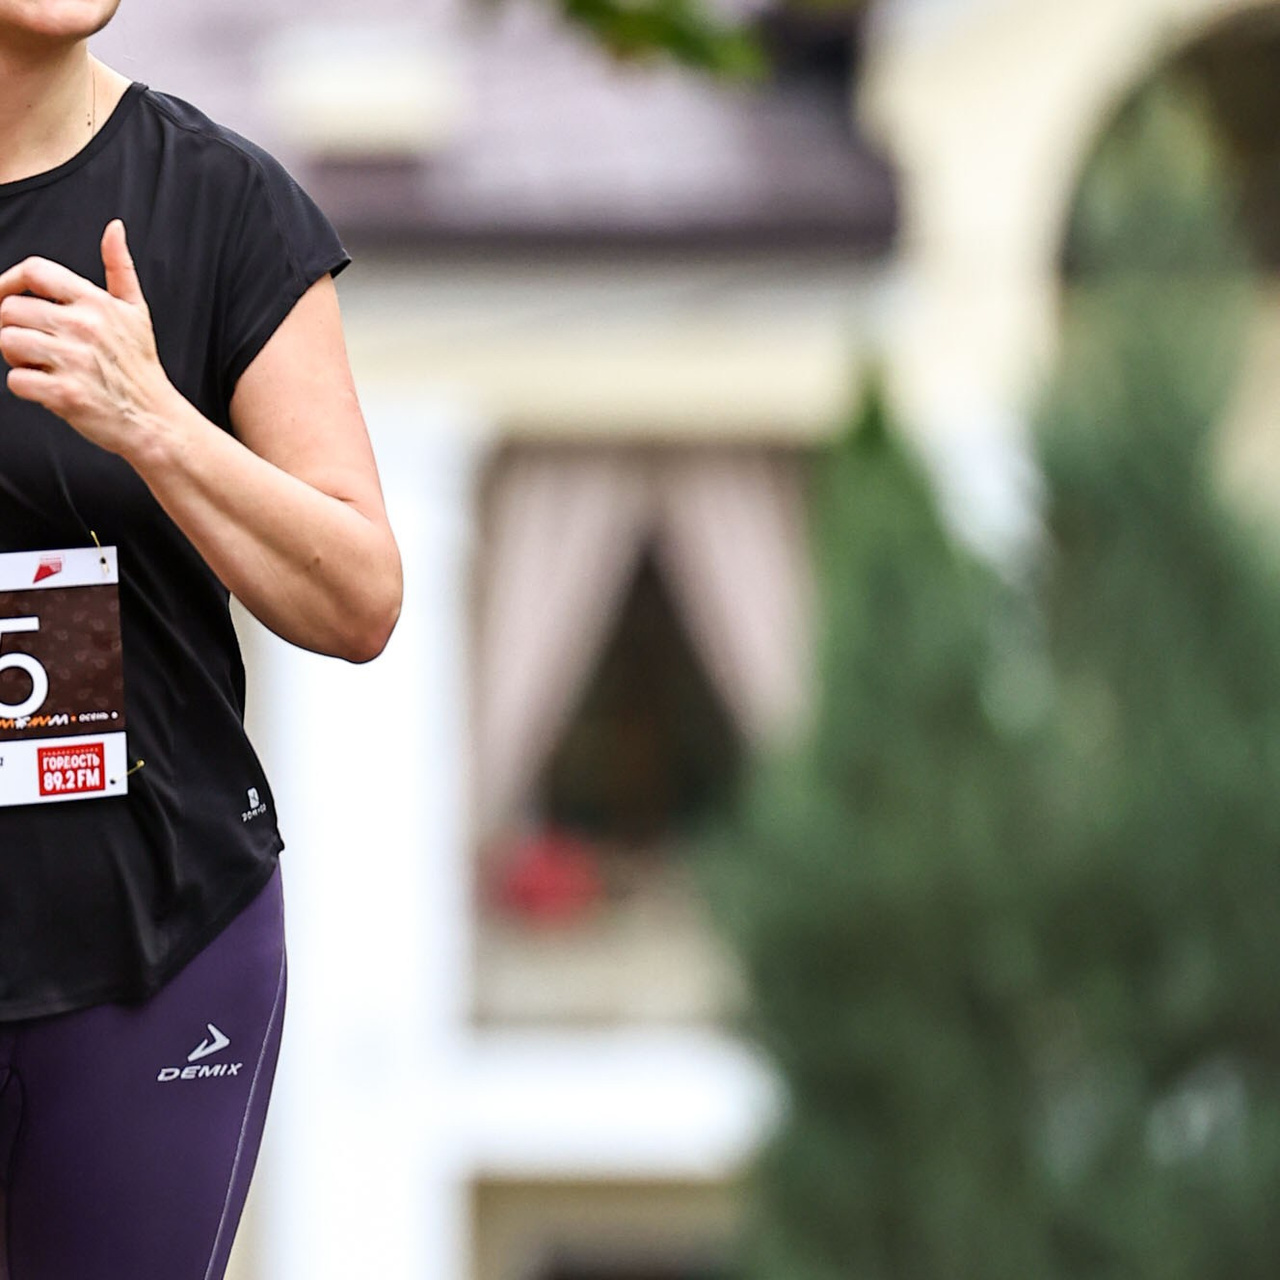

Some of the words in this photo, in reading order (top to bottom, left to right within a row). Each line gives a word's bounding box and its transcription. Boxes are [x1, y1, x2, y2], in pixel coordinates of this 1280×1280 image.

[43, 769, 76, 791] 89.2
[76, 767, 100, 789] FM
[157, 1062, 243, 1082] DEMIX
